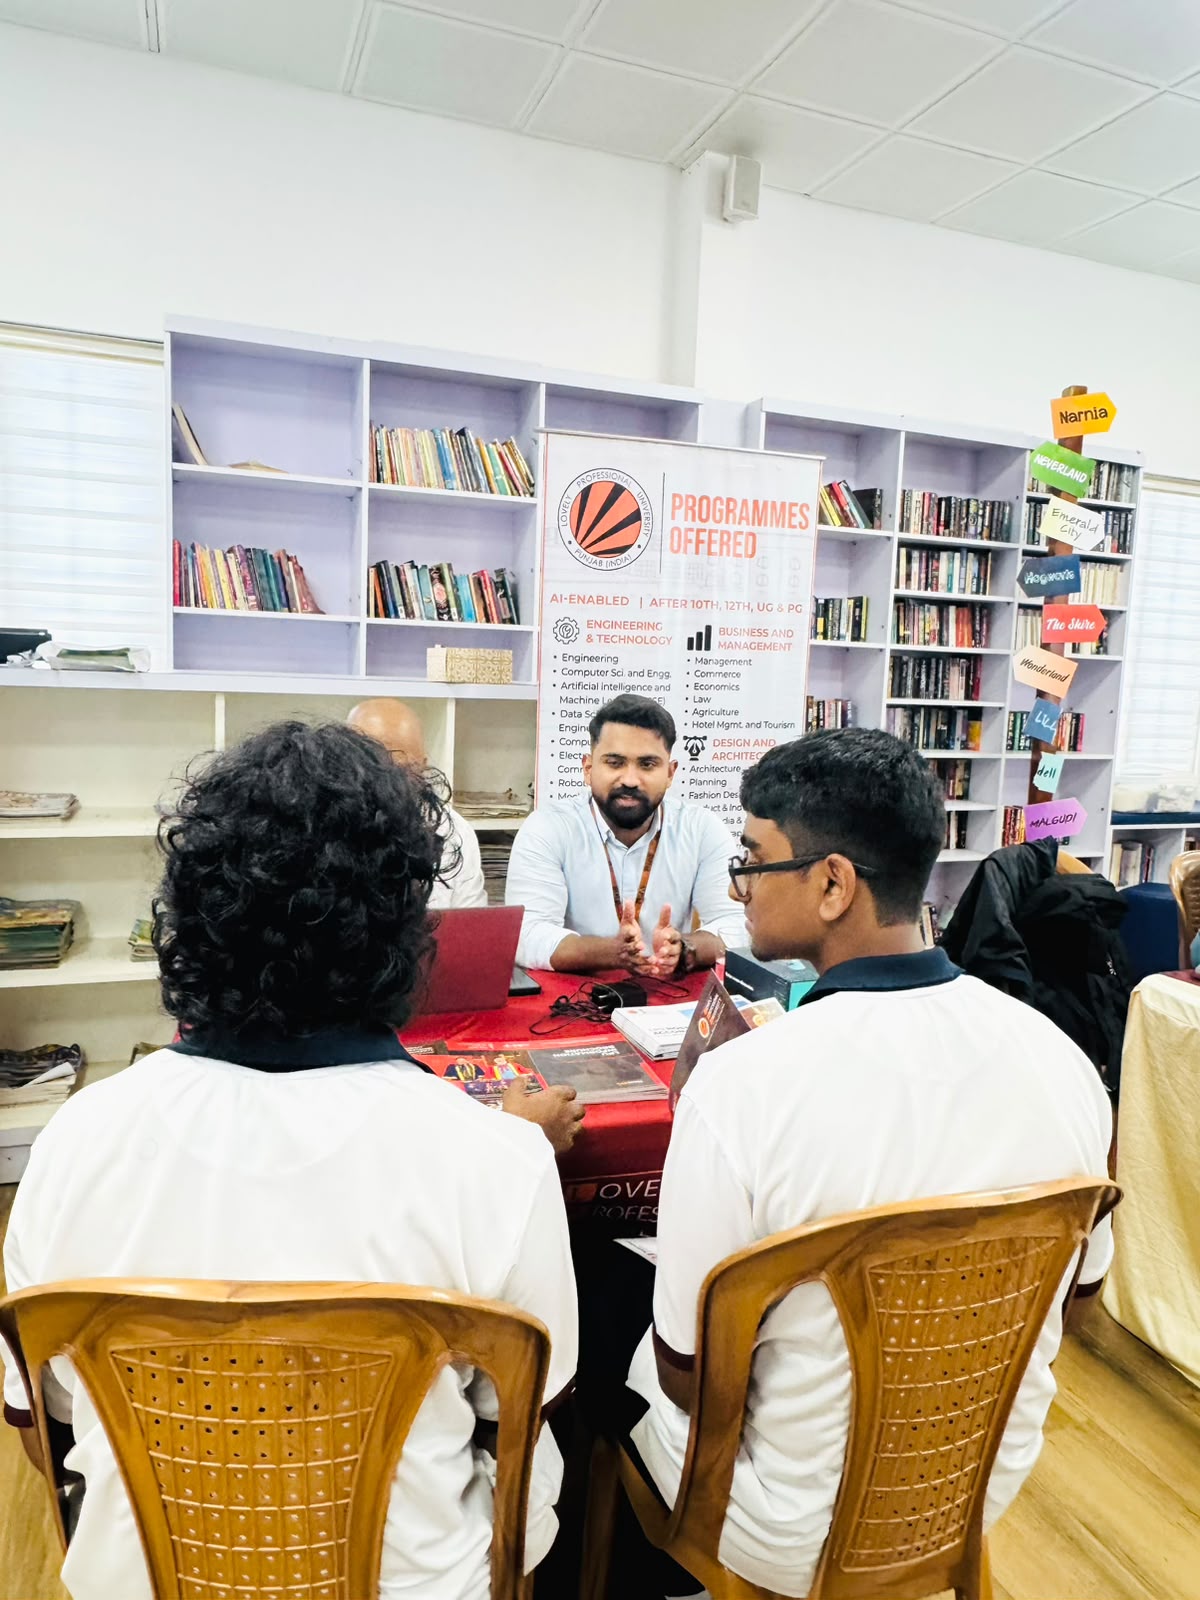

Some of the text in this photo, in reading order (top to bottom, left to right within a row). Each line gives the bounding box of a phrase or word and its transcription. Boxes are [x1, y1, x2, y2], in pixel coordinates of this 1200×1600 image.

[1059, 406, 1109, 424] Narnia
[1033, 453, 1088, 484] NEVERLAND
[560, 471, 651, 537] LOVELY PROFESSIONAL UNIVERSITY
[671, 492, 810, 530] PROGRAMMES
[1051, 508, 1099, 534] Emerald
[669, 526, 757, 559] OFFERED
[574, 548, 603, 567] PUNJAB
[550, 593, 803, 613] AI-ENABLED AFTER 10TH, 12TH, UG & PG
[586, 619, 663, 631] ENGINEERING
[1046, 617, 1096, 631] The Shire
[719, 627, 794, 639] BUSINESS AND
[586, 634, 673, 645] & TECHNOLOGY
[718, 641, 793, 652] MANAGEMENT
[562, 653, 619, 665] Engineering
[695, 657, 752, 668] Management
[561, 668, 609, 678] Computer
[628, 669, 645, 677] and
[647, 669, 672, 680] Engg.
[694, 669, 742, 679] Commerce
[1019, 658, 1070, 683] Wonderland
[560, 682, 671, 693] Artificial Intelligence and
[693, 682, 740, 691] Economics
[559, 696, 600, 705] Machine
[693, 695, 712, 704] Law
[560, 710, 583, 719] Data
[692, 707, 740, 718] Agriculture
[692, 720, 715, 729] Hotel
[745, 721, 762, 729] and
[763, 720, 795, 729] Tourism
[559, 737, 591, 747] Compu
[712, 738, 776, 747] DESIGN AND
[689, 765, 741, 774] Architecture
[1037, 765, 1057, 779] dell
[689, 778, 727, 787] Planning
[688, 791, 740, 800] Fashion Des
[722, 804, 729, 812] &
[729, 804, 742, 812] Ind
[1030, 812, 1077, 828] MALGUDI
[600, 1179, 661, 1199] OVE
[592, 1205, 659, 1223] ROFES
